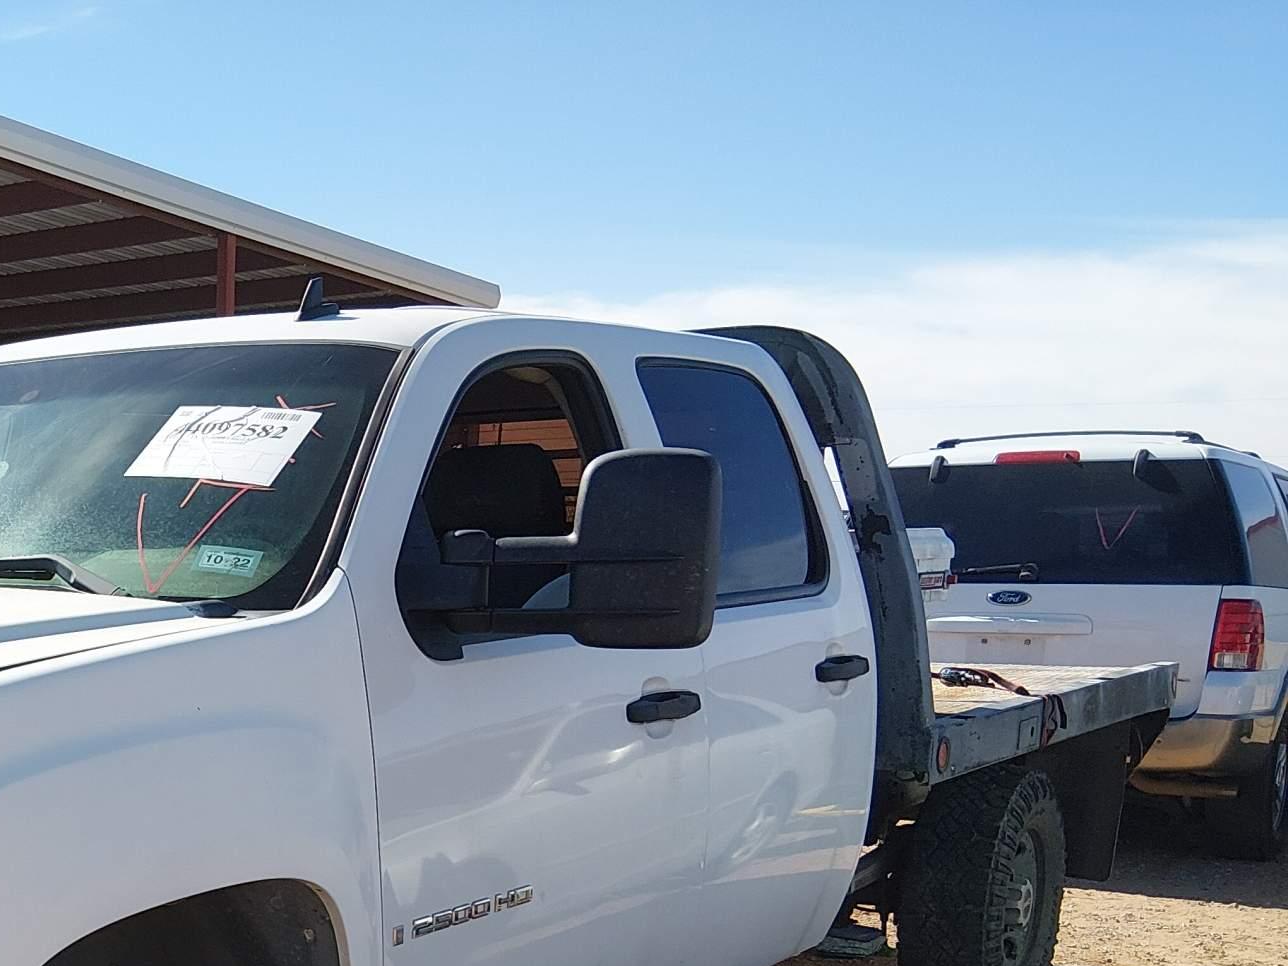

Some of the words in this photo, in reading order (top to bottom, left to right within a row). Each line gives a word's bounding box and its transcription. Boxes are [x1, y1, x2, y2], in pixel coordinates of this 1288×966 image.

[997, 592, 1022, 603] Ford
[412, 897, 491, 940] 2500
[494, 884, 534, 912] HD
